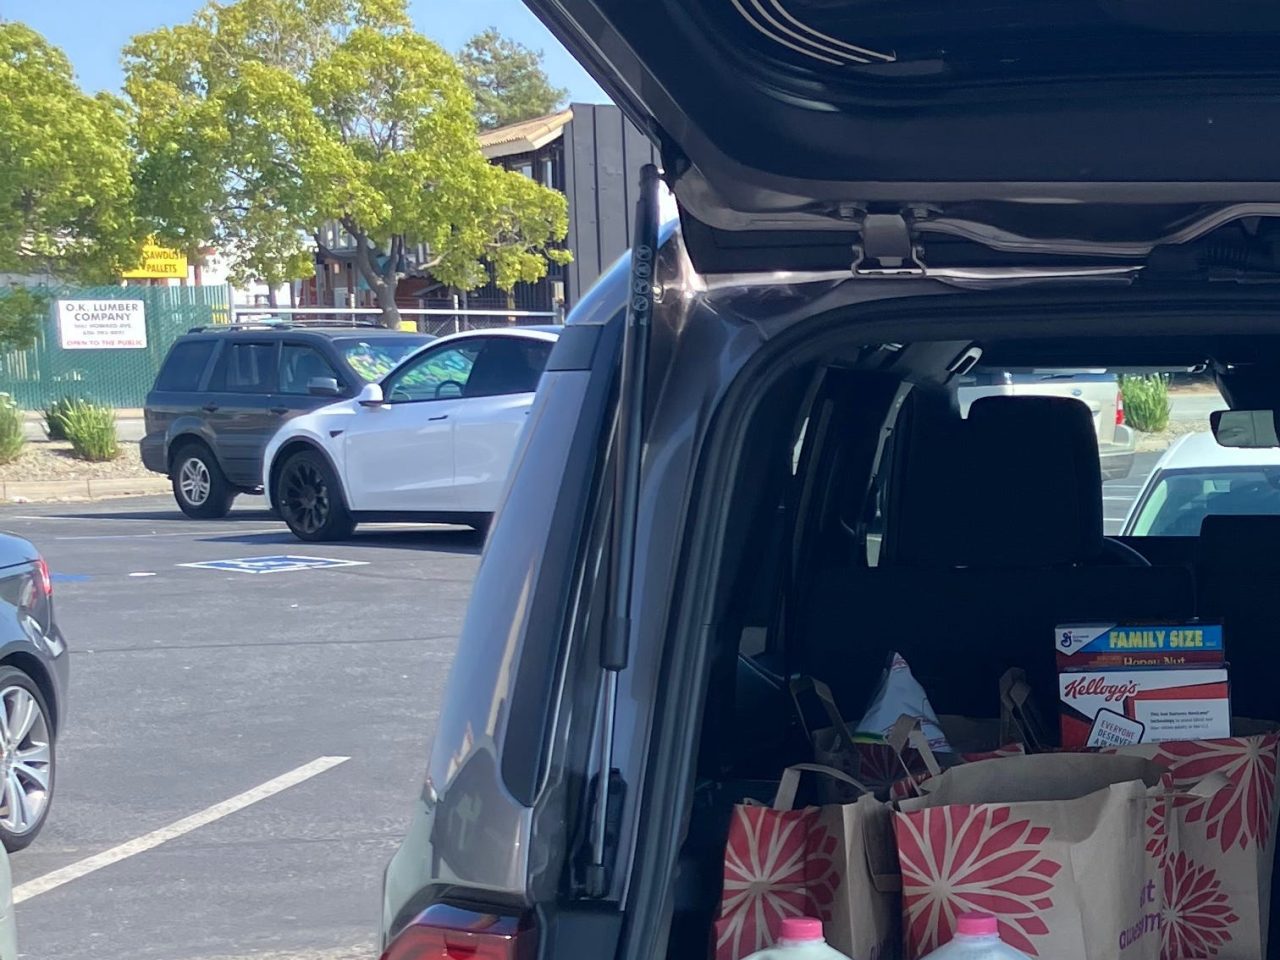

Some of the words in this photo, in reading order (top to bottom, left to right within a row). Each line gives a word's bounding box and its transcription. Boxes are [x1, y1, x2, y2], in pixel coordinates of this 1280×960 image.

[146, 263, 177, 273] PALLETS
[65, 303, 90, 312] O.K.
[93, 303, 138, 312] LUMBER
[74, 312, 132, 321] COMPANY
[1109, 630, 1166, 648] FAMILY
[1169, 630, 1203, 648] SIZE
[1064, 676, 1138, 702] Kellogg's
[1100, 720, 1136, 740] EVERYONE
[1118, 912, 1162, 951] awesom
